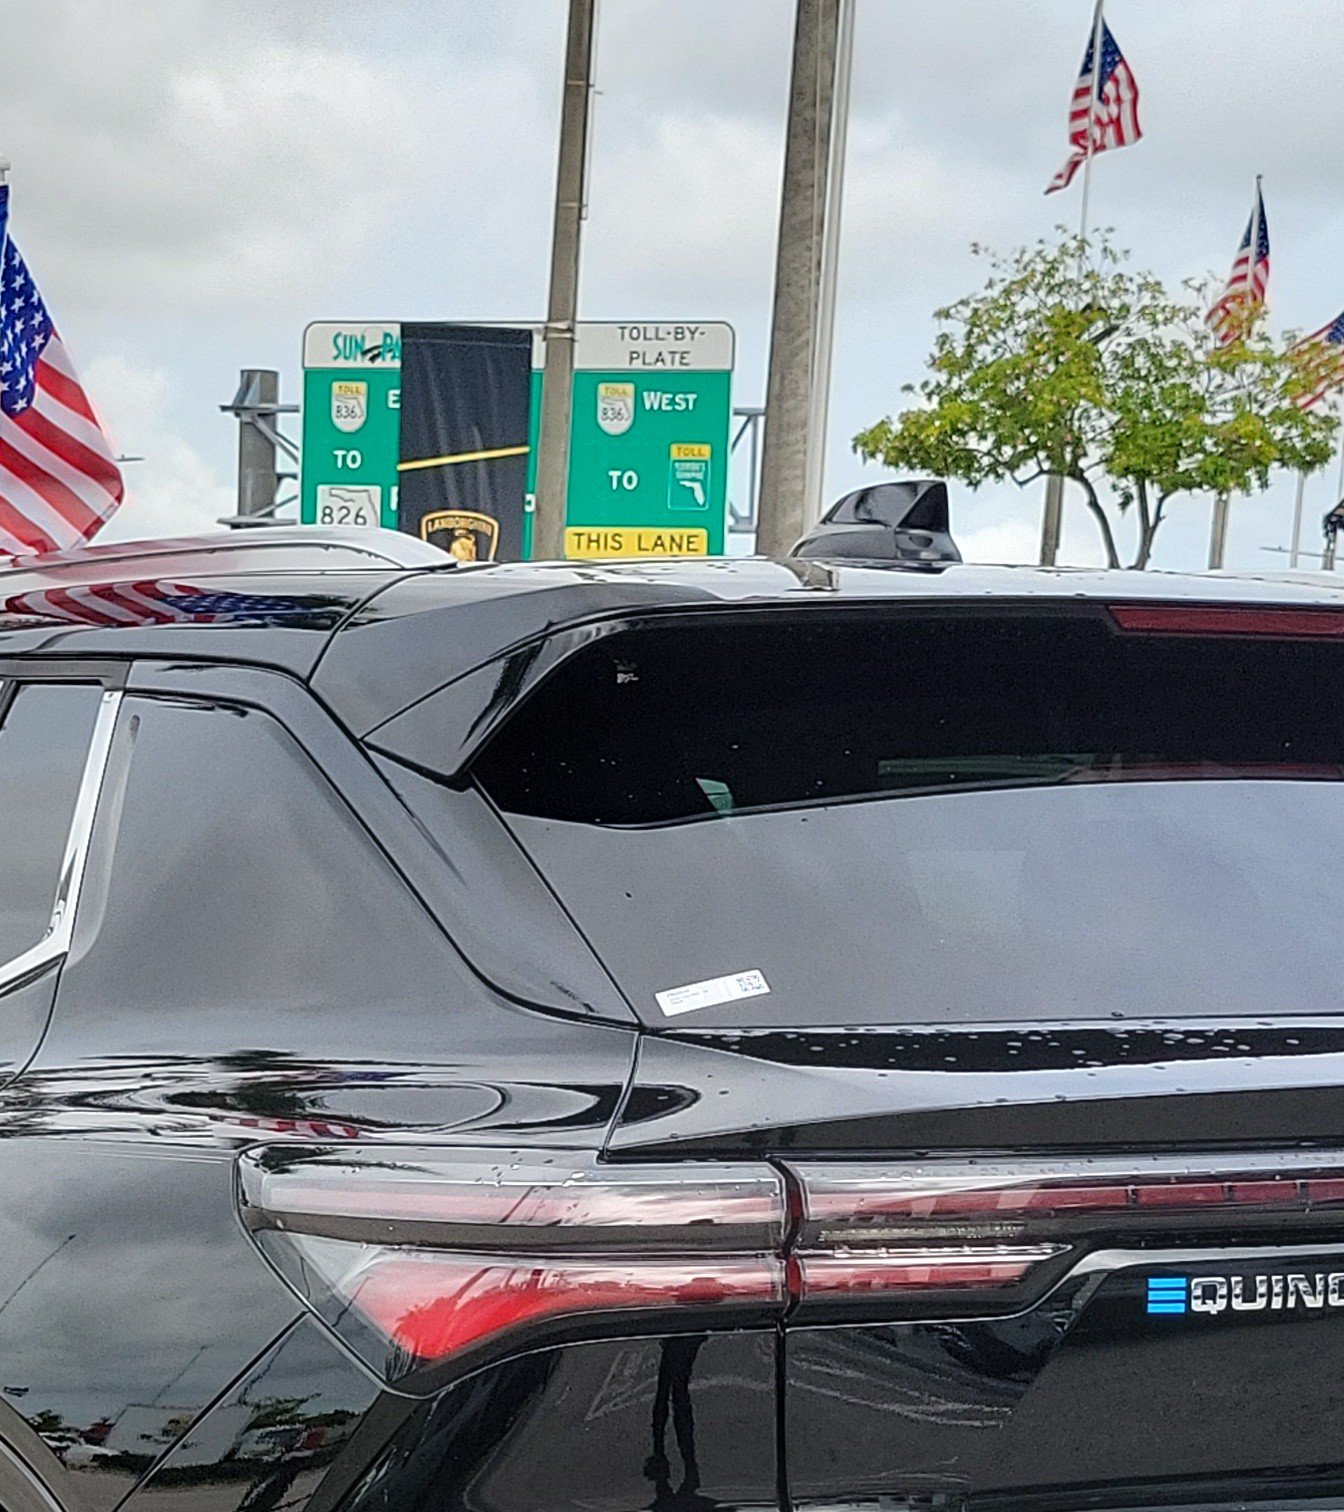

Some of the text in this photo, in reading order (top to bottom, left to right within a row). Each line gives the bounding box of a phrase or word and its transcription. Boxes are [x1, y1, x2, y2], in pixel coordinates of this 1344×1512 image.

[617, 326, 706, 341] TOLL-BY-
[628, 351, 691, 366] PLATE
[642, 391, 698, 411] WEST
[333, 449, 362, 469] TO
[676, 446, 706, 457] TOLL
[608, 470, 638, 490] TO
[320, 505, 368, 526] 826
[573, 532, 699, 552] THIS LANE
